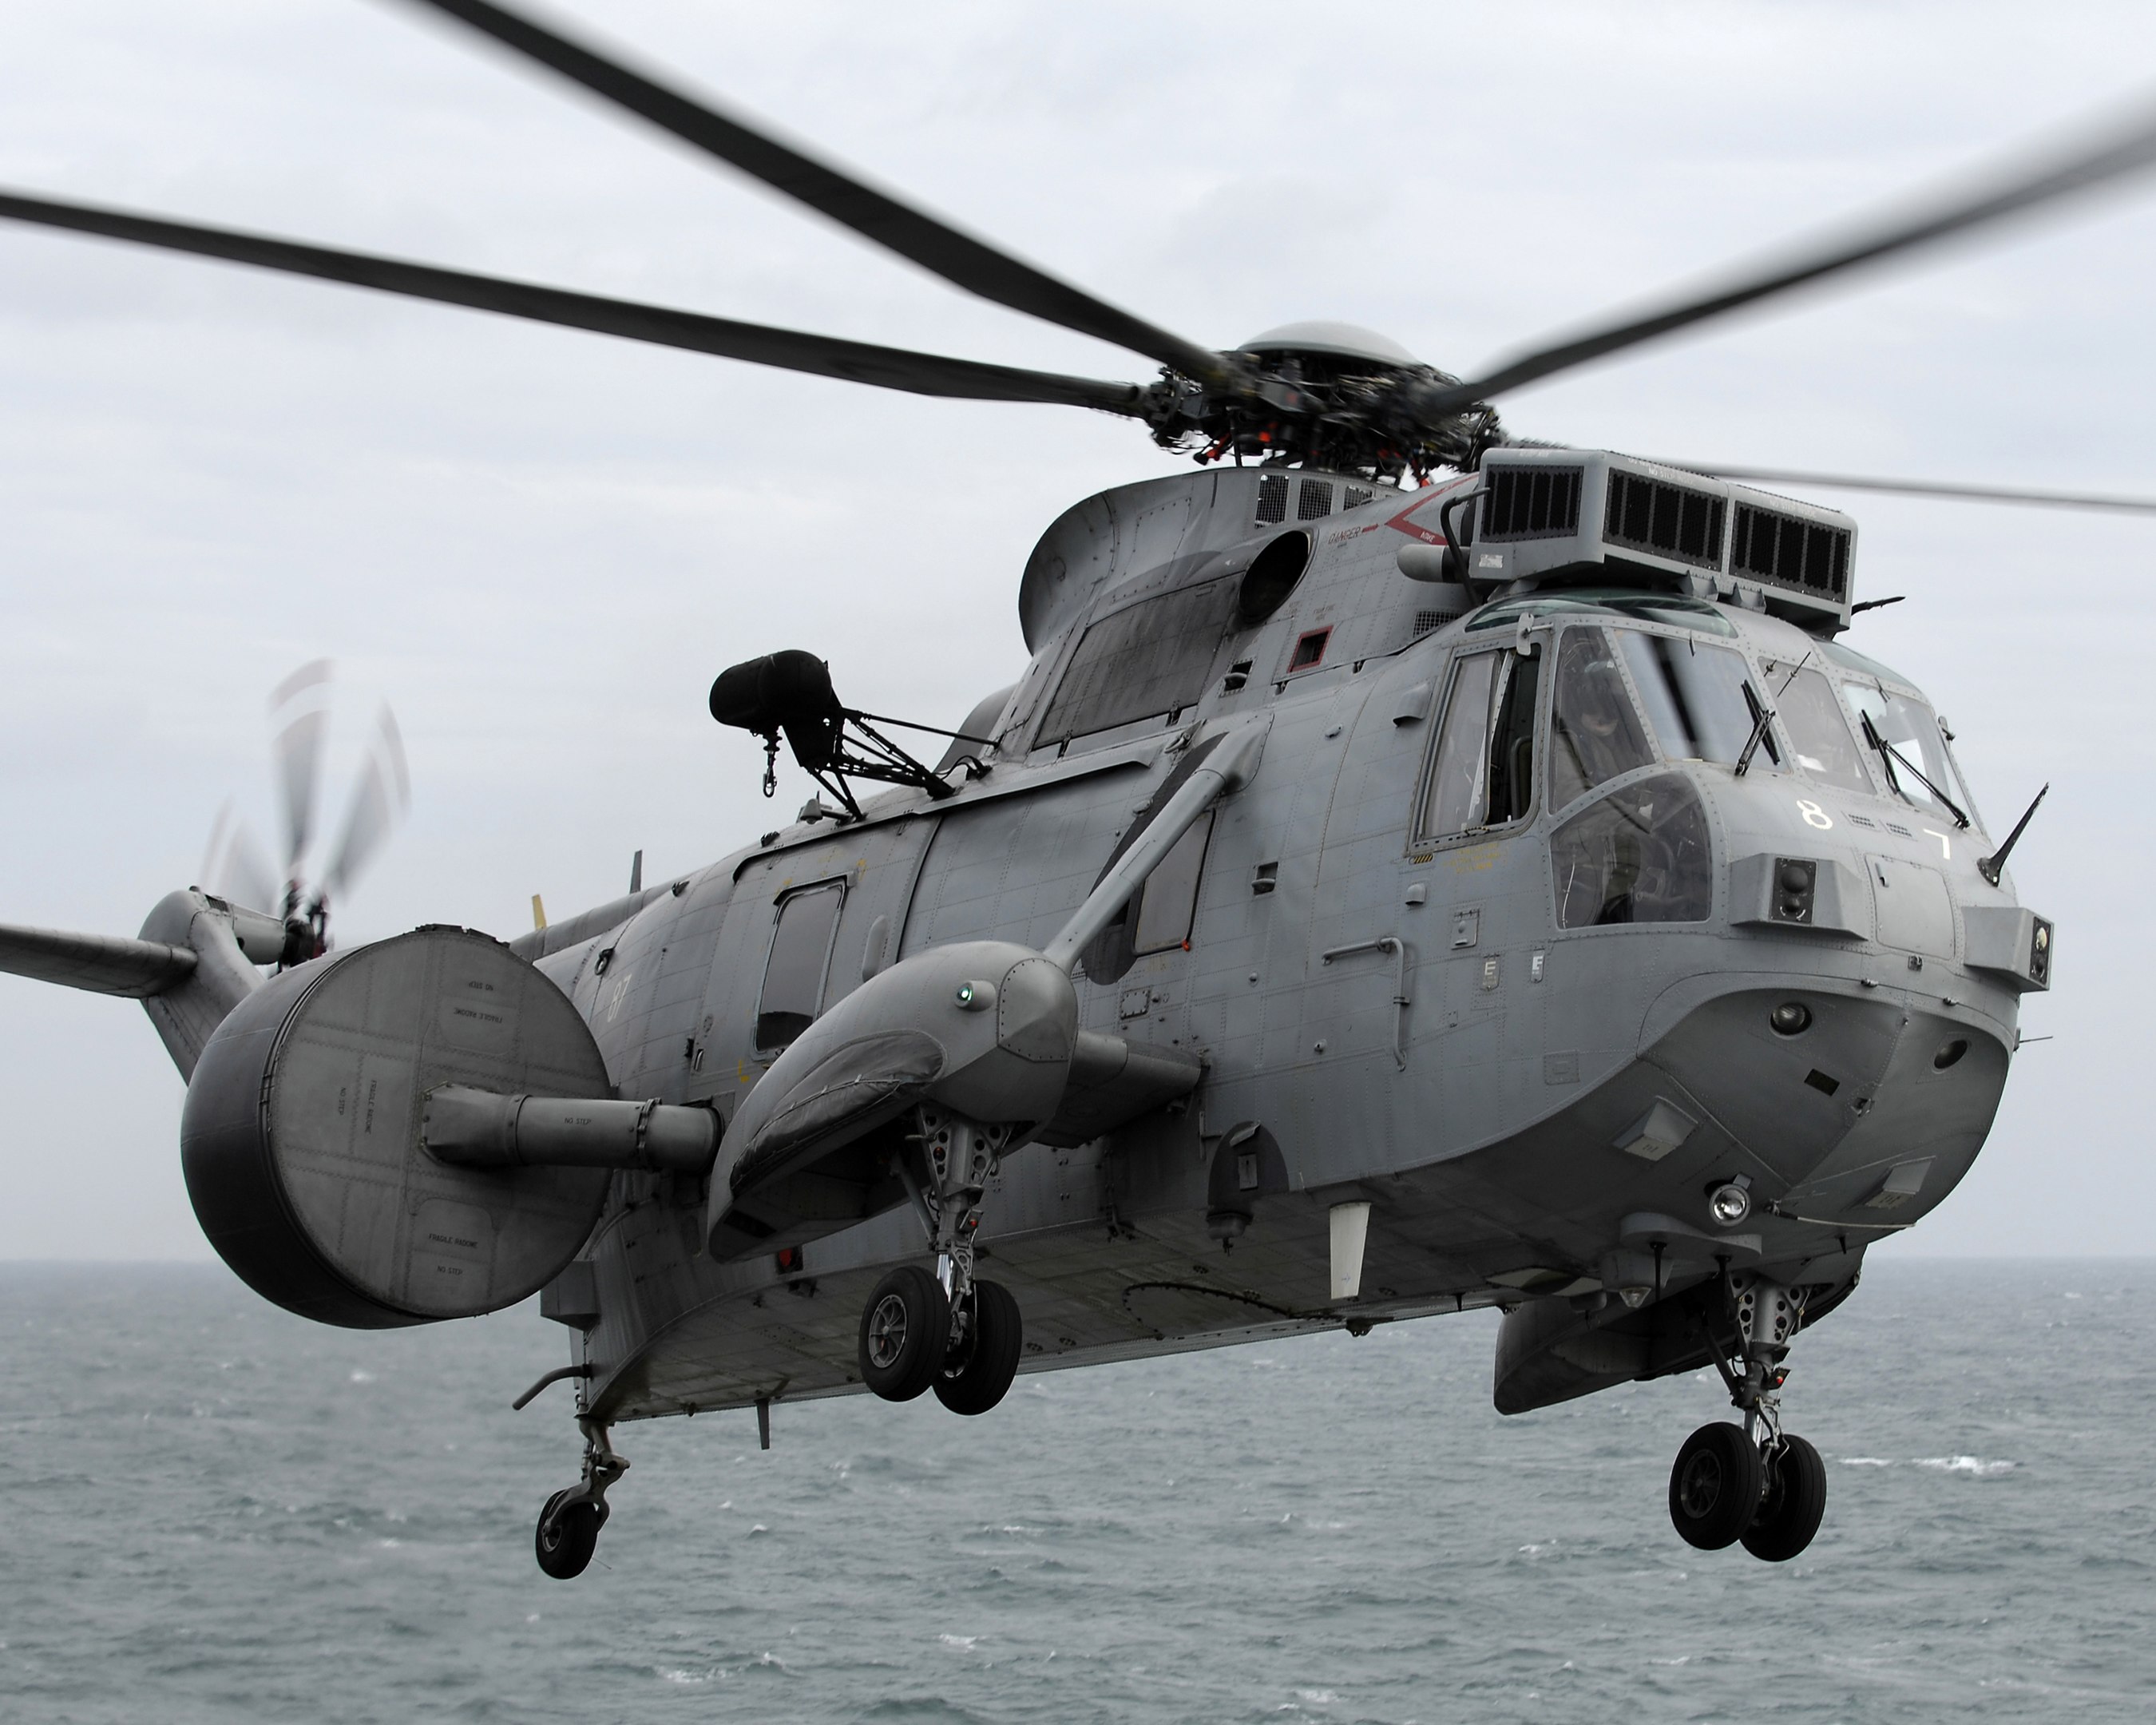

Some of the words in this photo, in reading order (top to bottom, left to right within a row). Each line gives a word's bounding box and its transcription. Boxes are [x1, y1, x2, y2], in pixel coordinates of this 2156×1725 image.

[1328, 526, 1361, 544] DANGER
[1797, 799, 1833, 822] 8
[1923, 827, 1951, 860] 7
[1484, 961, 1497, 976] E
[608, 974, 632, 1022] 87
[428, 1233, 453, 1244] FRAGILE
